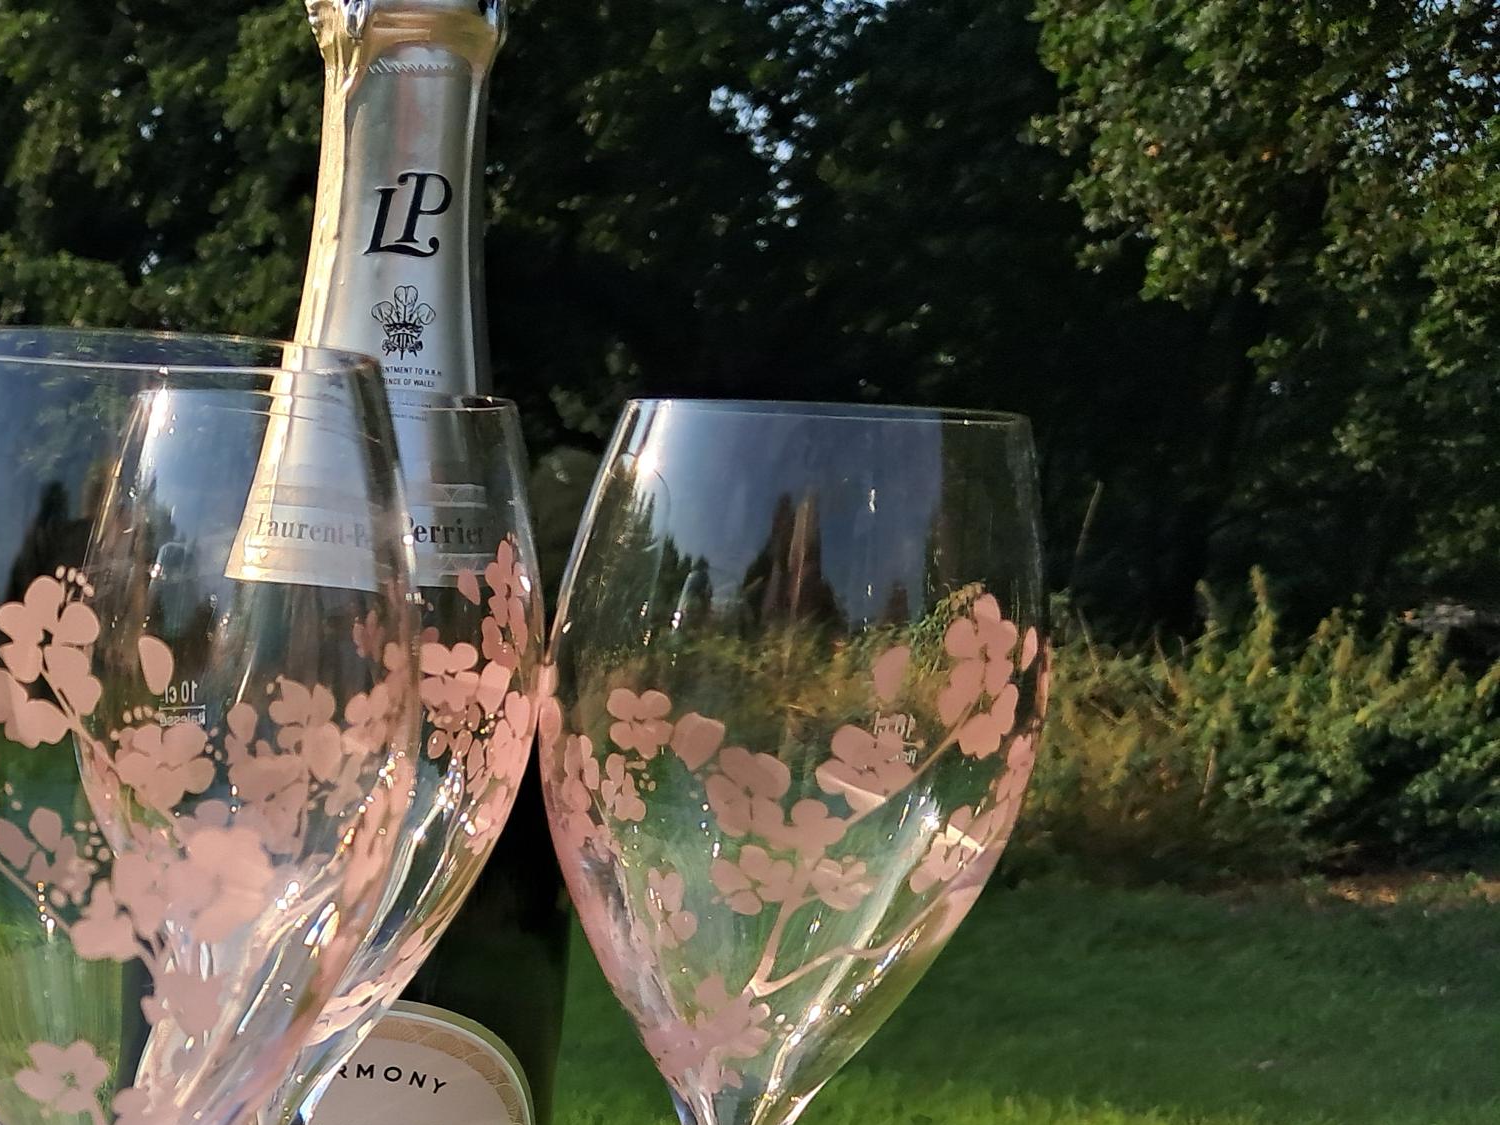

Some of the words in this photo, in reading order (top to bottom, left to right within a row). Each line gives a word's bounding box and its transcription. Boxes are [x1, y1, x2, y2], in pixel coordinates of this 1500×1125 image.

[363, 171, 453, 258] LP
[382, 365, 412, 374] NTMENT
[384, 378, 401, 386] INCE
[337, 1063, 447, 1094] RMONY
